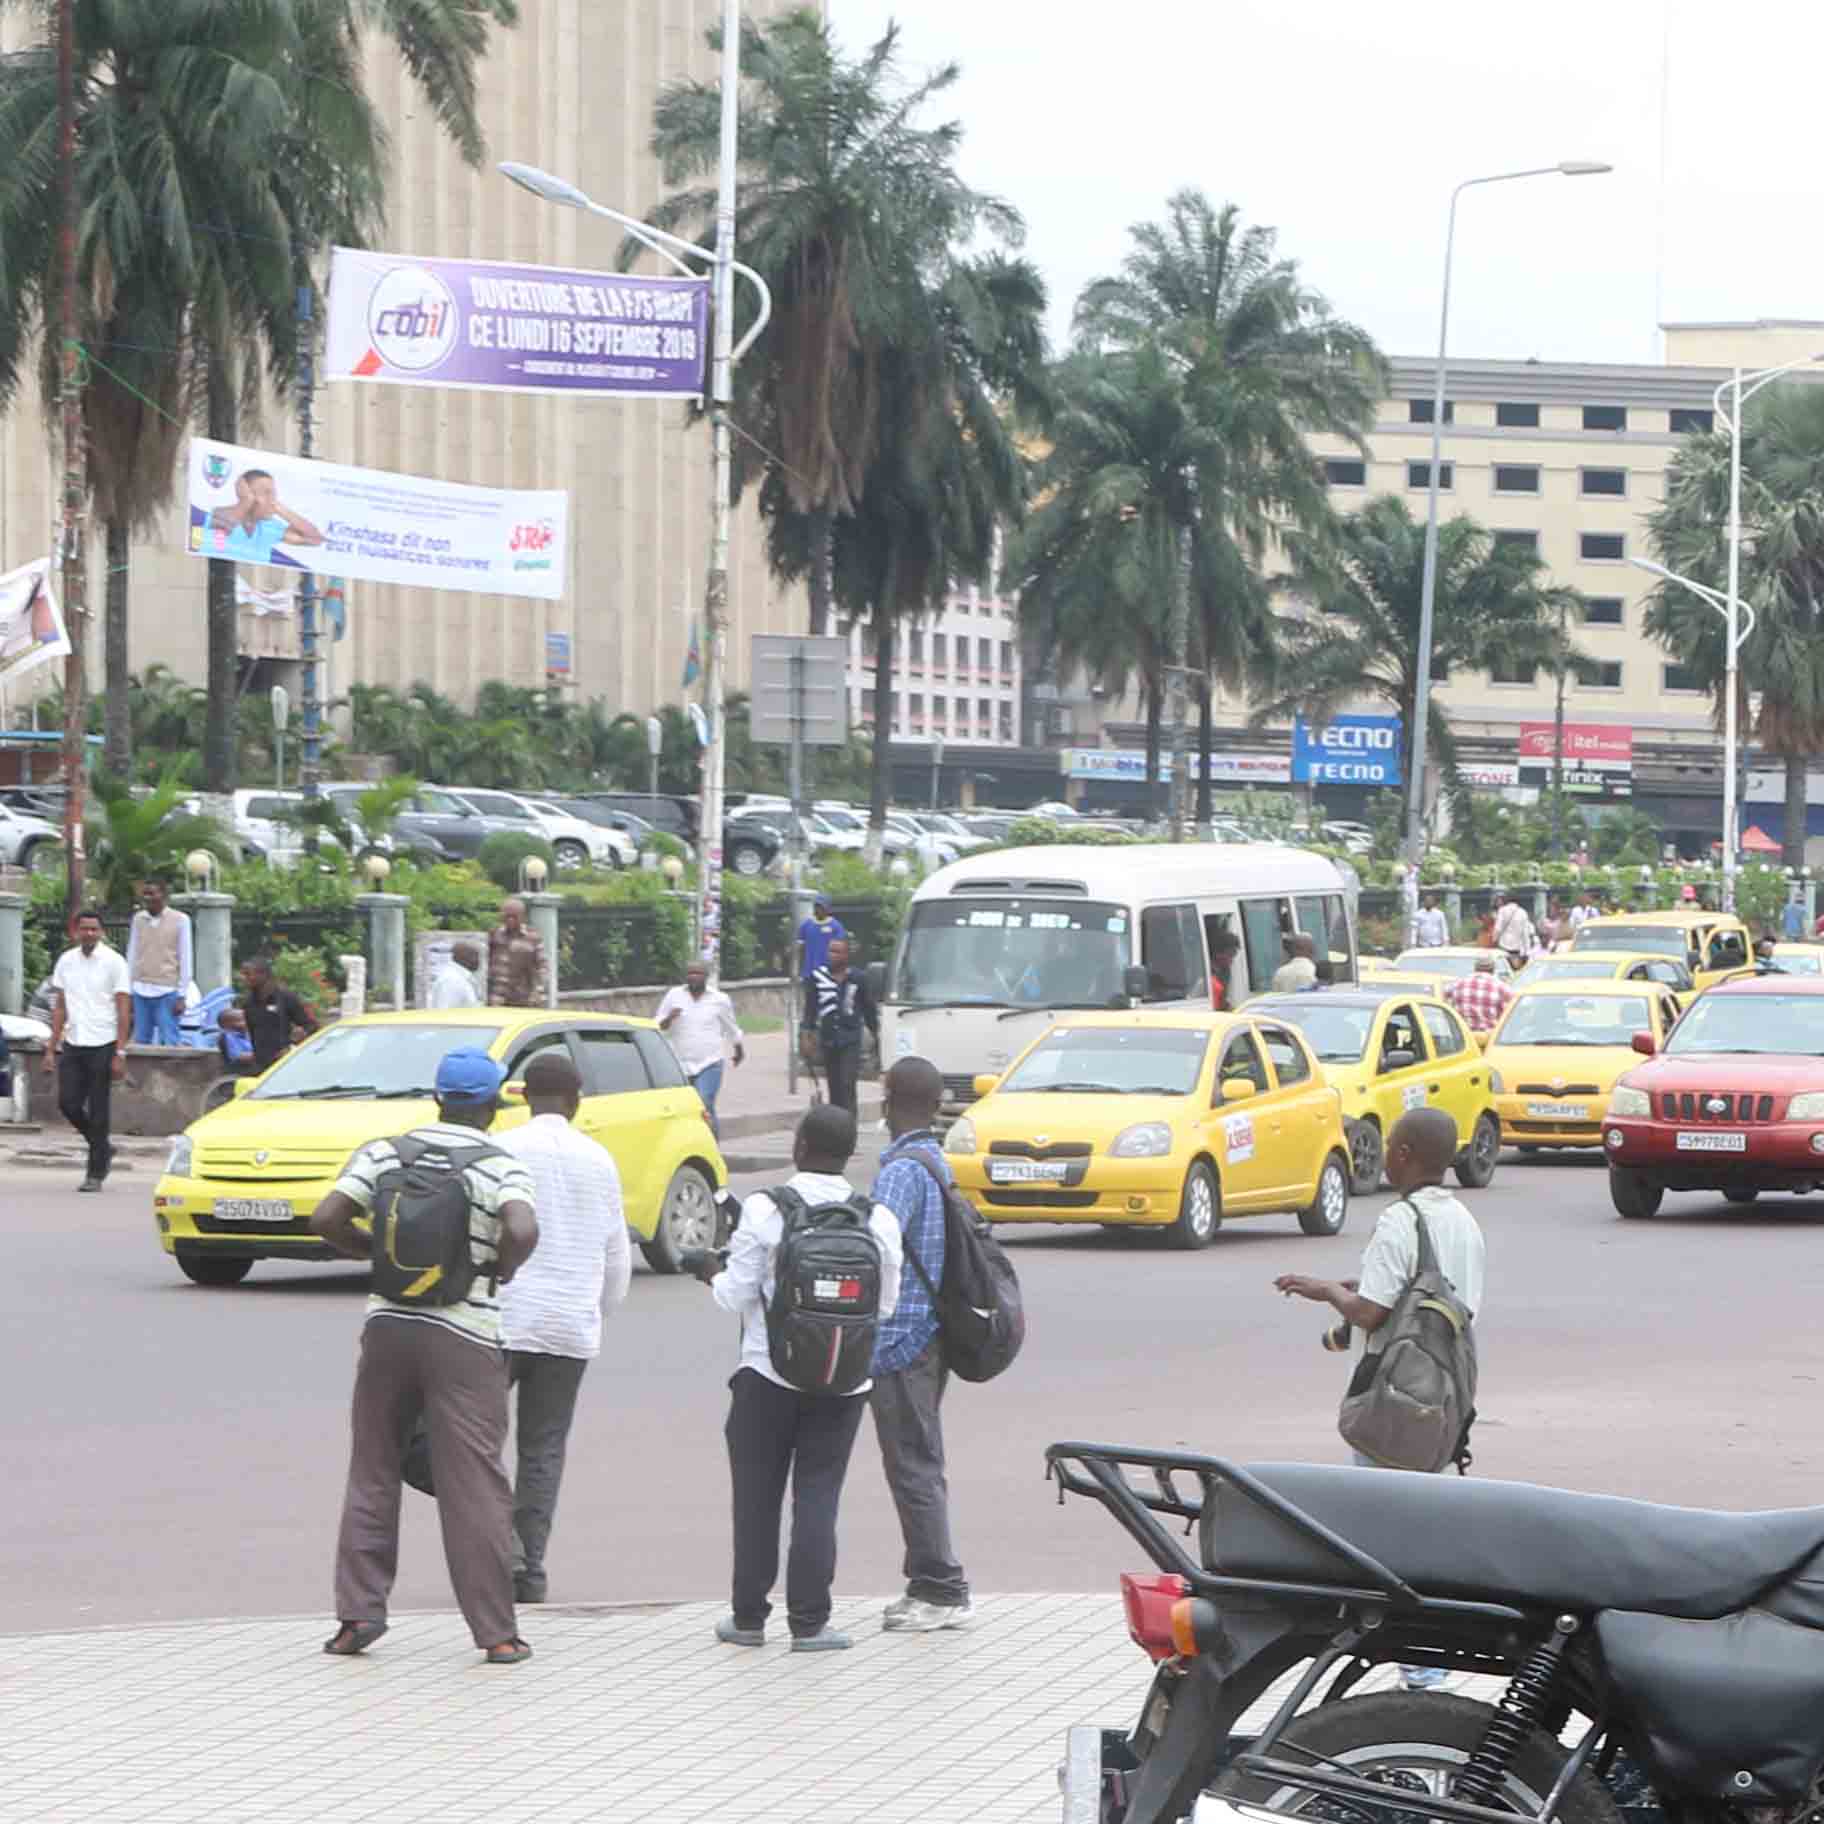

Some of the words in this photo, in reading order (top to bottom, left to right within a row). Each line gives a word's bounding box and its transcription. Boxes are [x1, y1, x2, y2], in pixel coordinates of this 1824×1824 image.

[498, 316, 549, 351] LUNDI
[551, 319, 572, 353] 16
[573, 322, 661, 359] SEPTEMBRE
[1302, 725, 1393, 749] TECNO
[1309, 761, 1386, 780] TECNO
